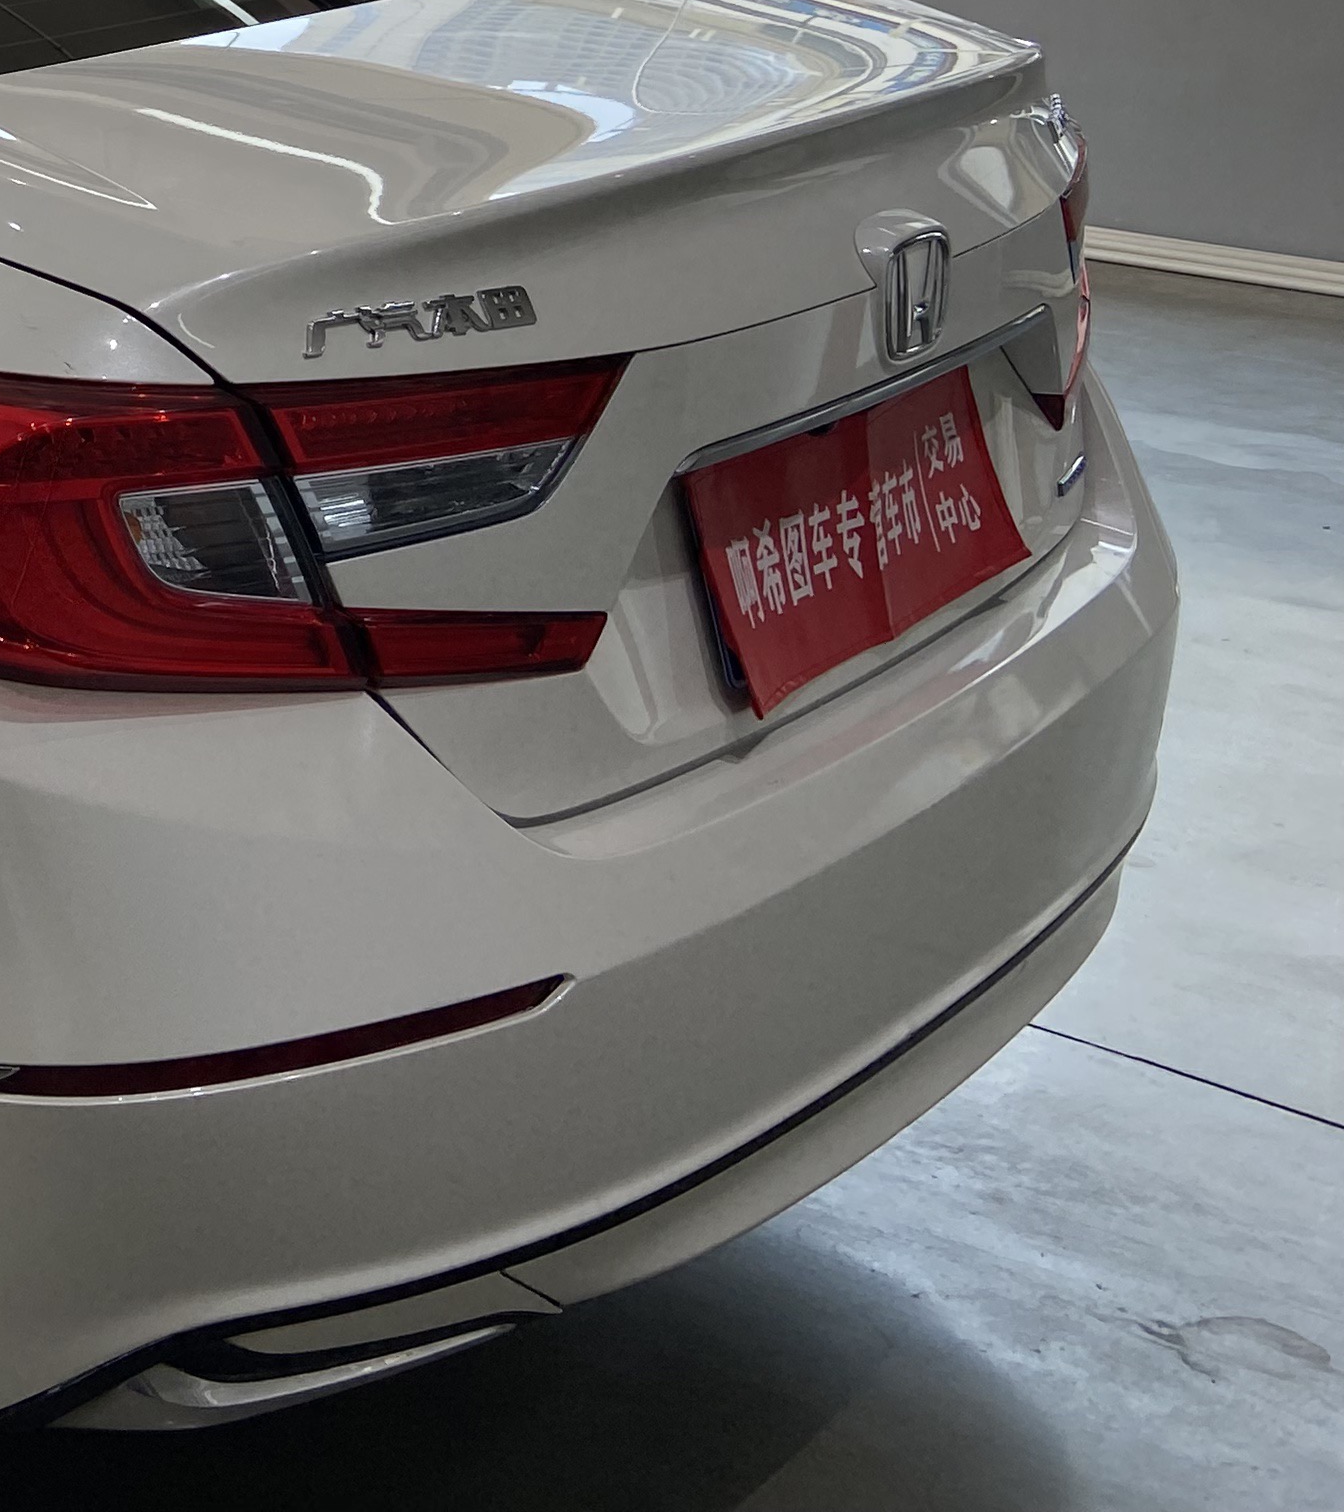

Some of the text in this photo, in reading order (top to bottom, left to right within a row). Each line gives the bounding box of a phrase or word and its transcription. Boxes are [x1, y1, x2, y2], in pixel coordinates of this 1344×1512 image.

[302, 286, 537, 359] 广汽本田
[922, 412, 964, 479] 交易
[935, 484, 982, 544] 中心
